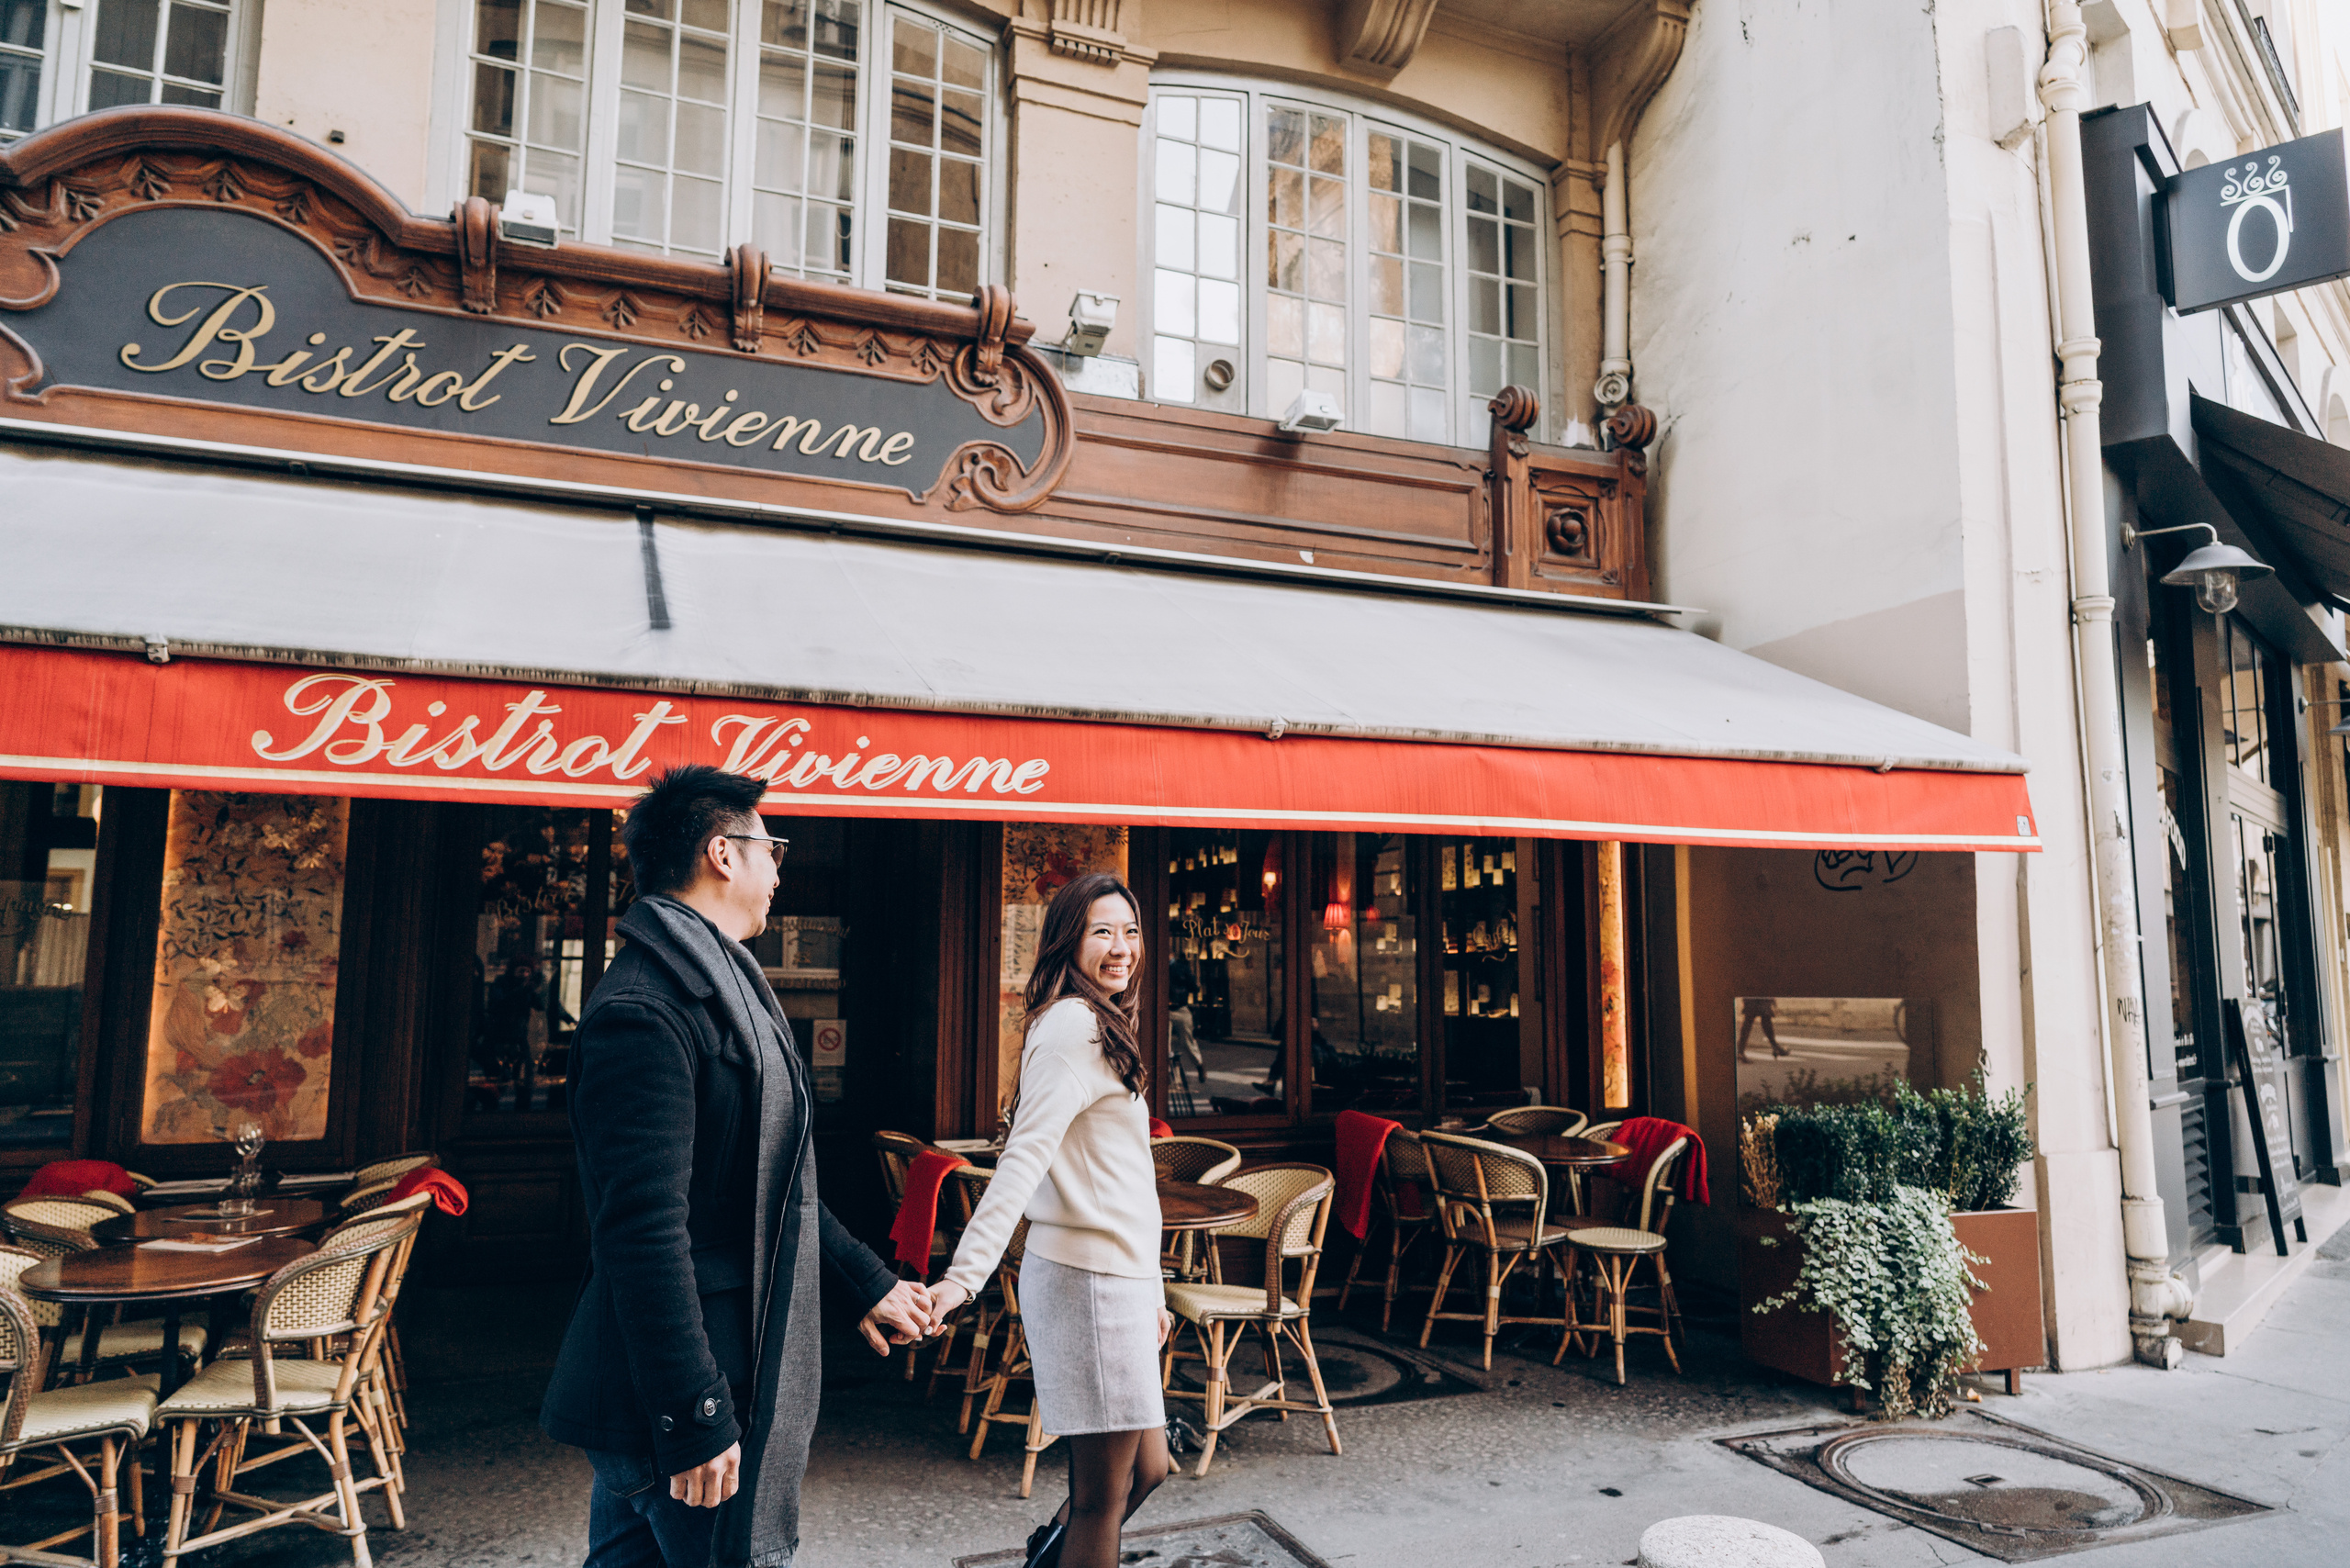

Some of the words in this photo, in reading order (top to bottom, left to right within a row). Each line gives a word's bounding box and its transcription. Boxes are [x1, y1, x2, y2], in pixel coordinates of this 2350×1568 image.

[119, 281, 536, 412] Bistrot
[549, 342, 915, 466] Vivienne
[251, 672, 688, 780] Bistrot
[711, 714, 1051, 795] Vivienne
[1182, 916, 1221, 941] Plat
